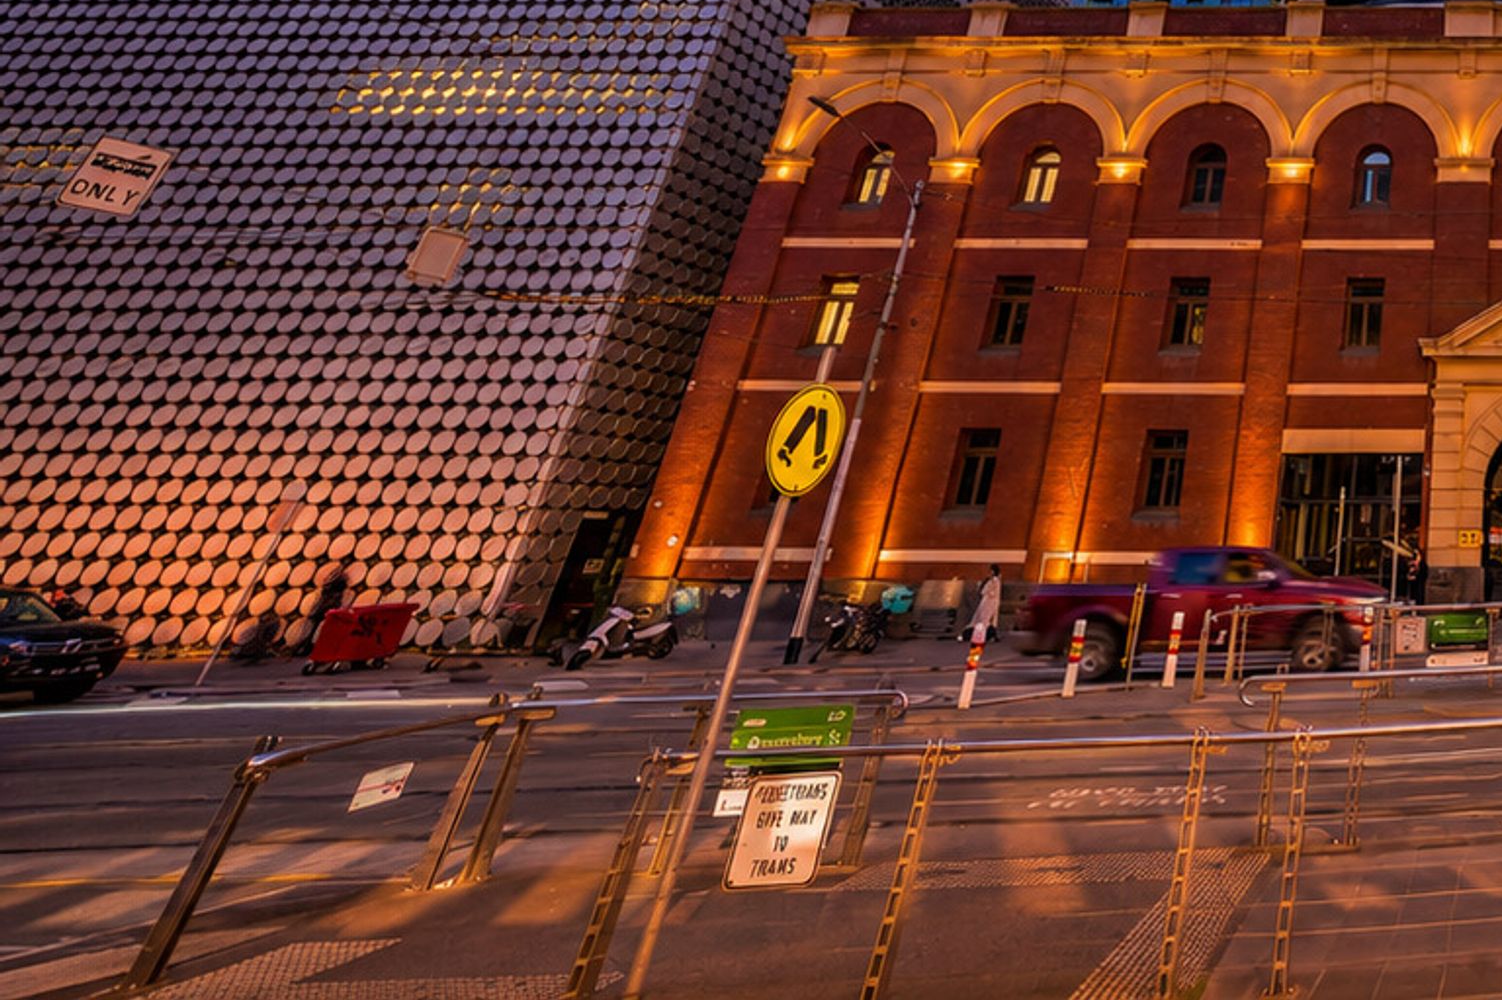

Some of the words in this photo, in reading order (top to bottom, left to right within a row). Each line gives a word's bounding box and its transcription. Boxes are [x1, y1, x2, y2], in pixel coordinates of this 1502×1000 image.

[70, 178, 140, 206] ONLY
[756, 810, 783, 828] GIVE
[773, 836, 788, 851] TO
